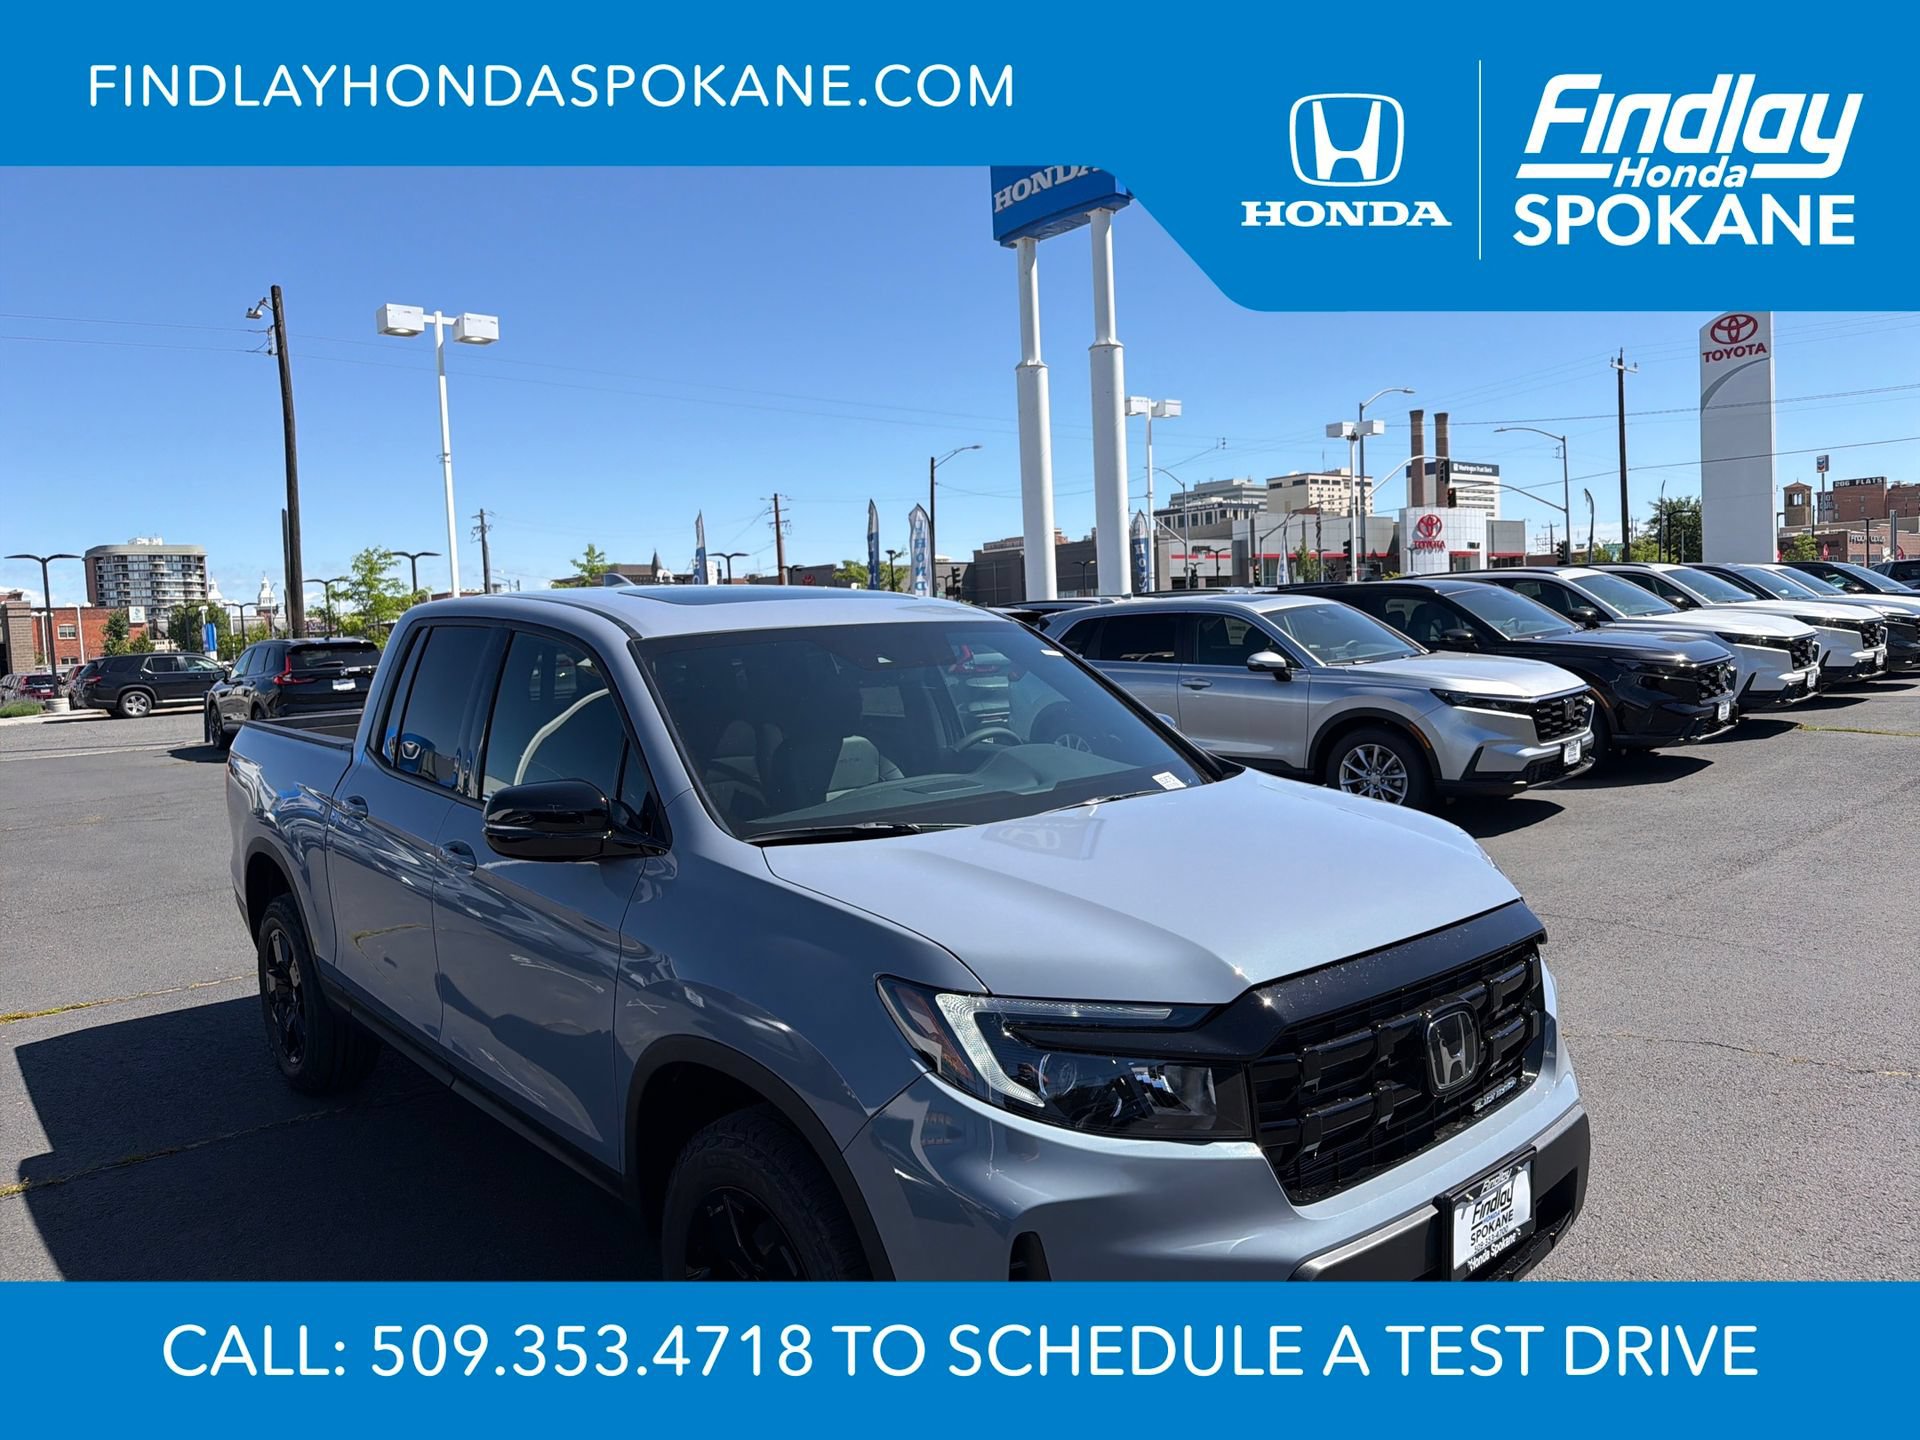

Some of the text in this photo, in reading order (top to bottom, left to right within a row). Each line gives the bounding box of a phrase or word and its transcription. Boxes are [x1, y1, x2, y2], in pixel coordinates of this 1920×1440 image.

[1703, 342, 1767, 363] TOYOTA
[1855, 478, 1882, 486] FLATS
[1413, 540, 1446, 551] TOYOTA
[1472, 1184, 1515, 1226] Findlay
[1470, 1208, 1514, 1246] SPOKANE
[1490, 1232, 1516, 1257] Spokane
